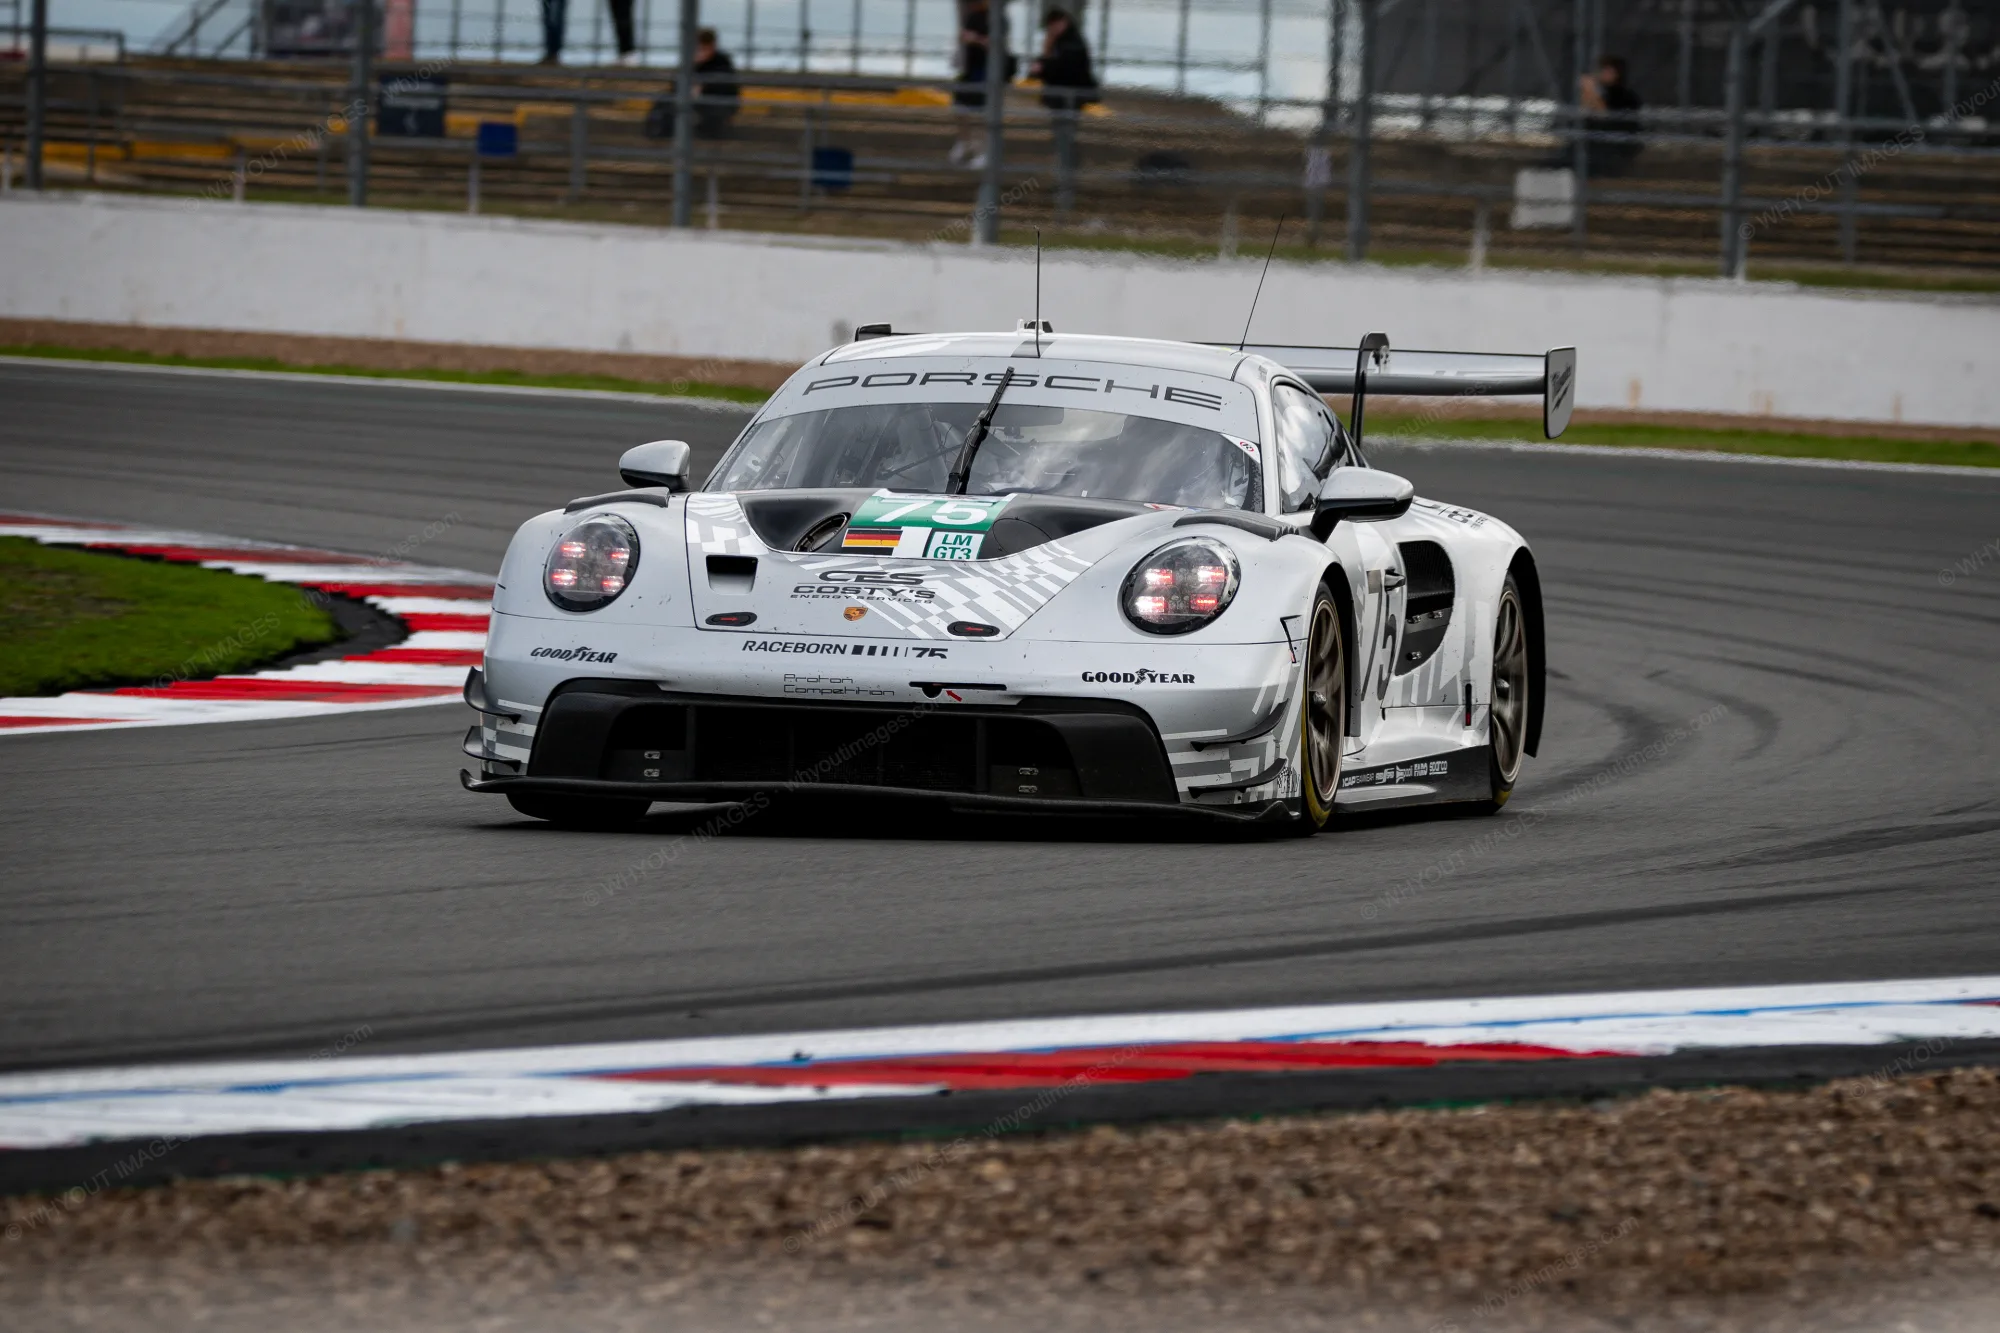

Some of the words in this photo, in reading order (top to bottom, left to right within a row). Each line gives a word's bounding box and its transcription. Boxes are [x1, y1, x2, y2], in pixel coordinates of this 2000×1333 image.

[802, 371, 1223, 411] PORSCHE
[873, 499, 995, 525] 75
[942, 534, 973, 546] LM
[933, 546, 973, 559] GT3
[818, 570, 926, 586] CES
[793, 585, 936, 599] COSTY'S
[742, 640, 848, 655] RACEBORN
[784, 673, 853, 684] Proton
[784, 685, 895, 696] Competition
